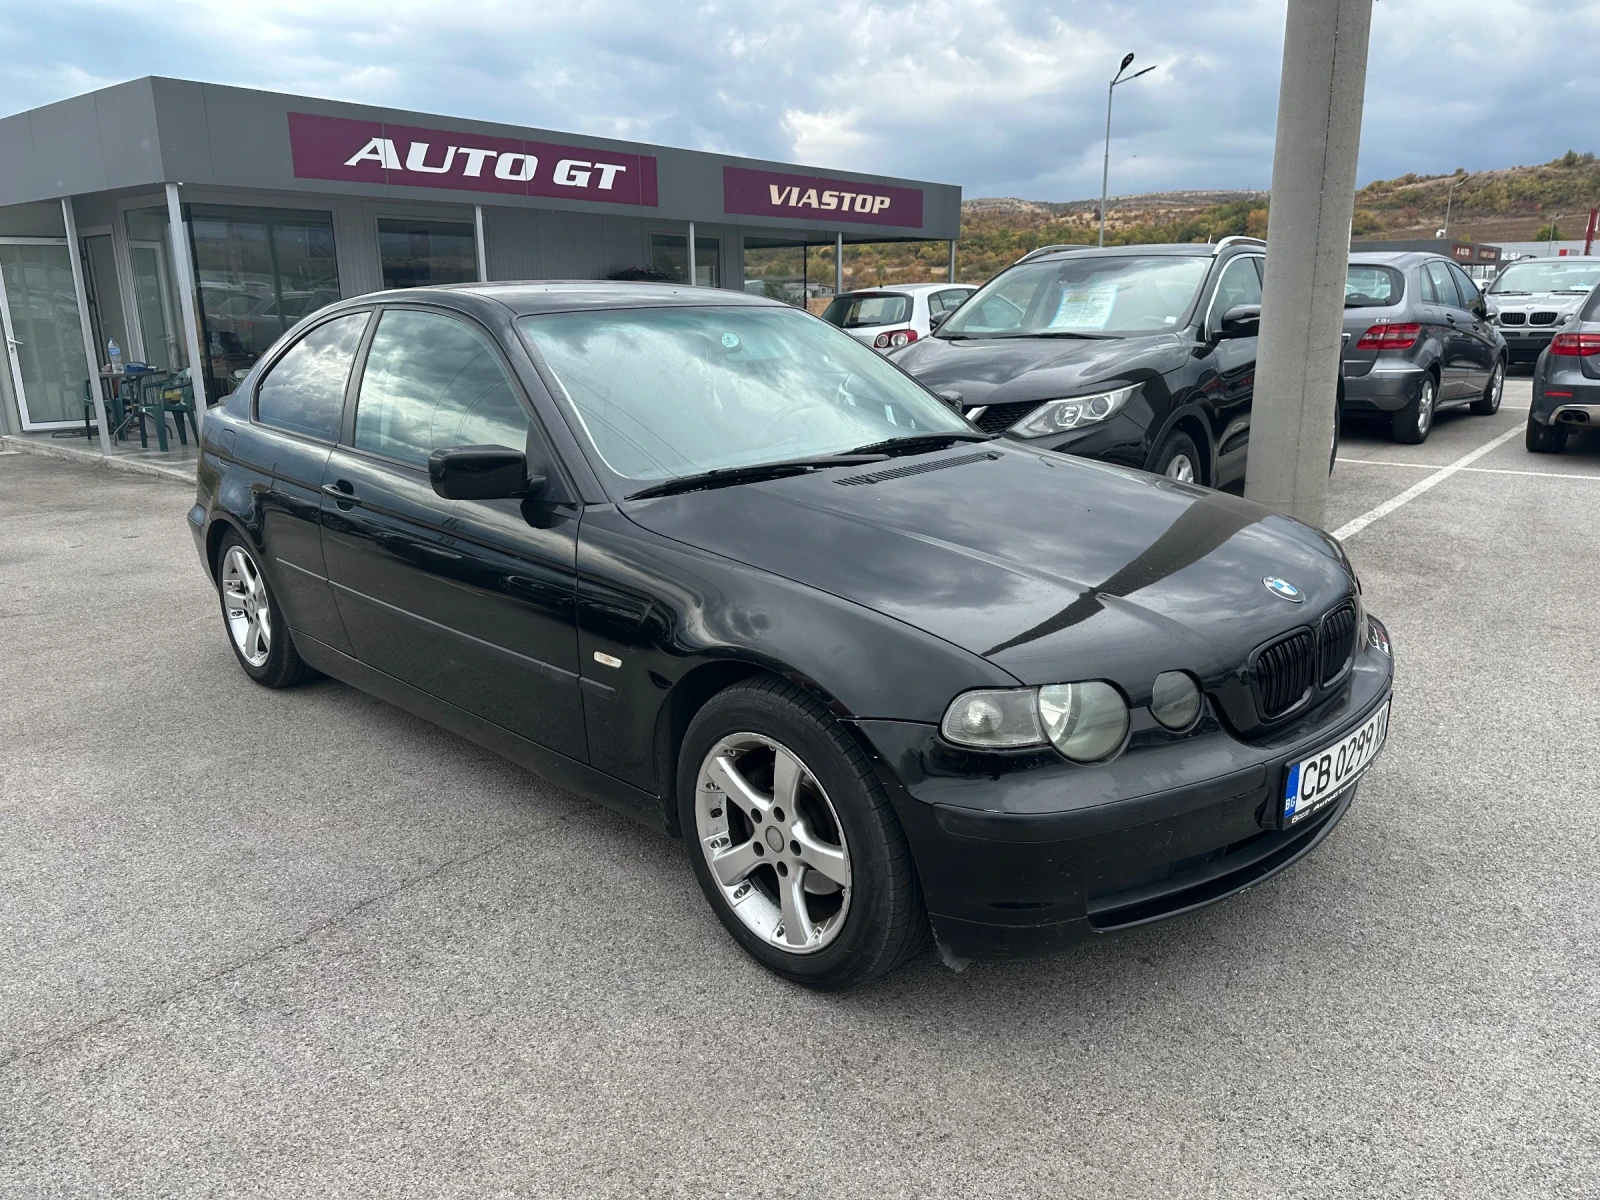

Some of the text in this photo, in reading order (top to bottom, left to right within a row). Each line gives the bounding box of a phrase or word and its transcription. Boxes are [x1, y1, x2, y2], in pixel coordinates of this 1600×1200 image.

[344, 137, 627, 190] AUTO GT
[769, 184, 891, 214] VIASTOP
[1301, 754, 1332, 801] CB
[1335, 722, 1374, 782] 0299
[1285, 796, 1296, 811] BG
